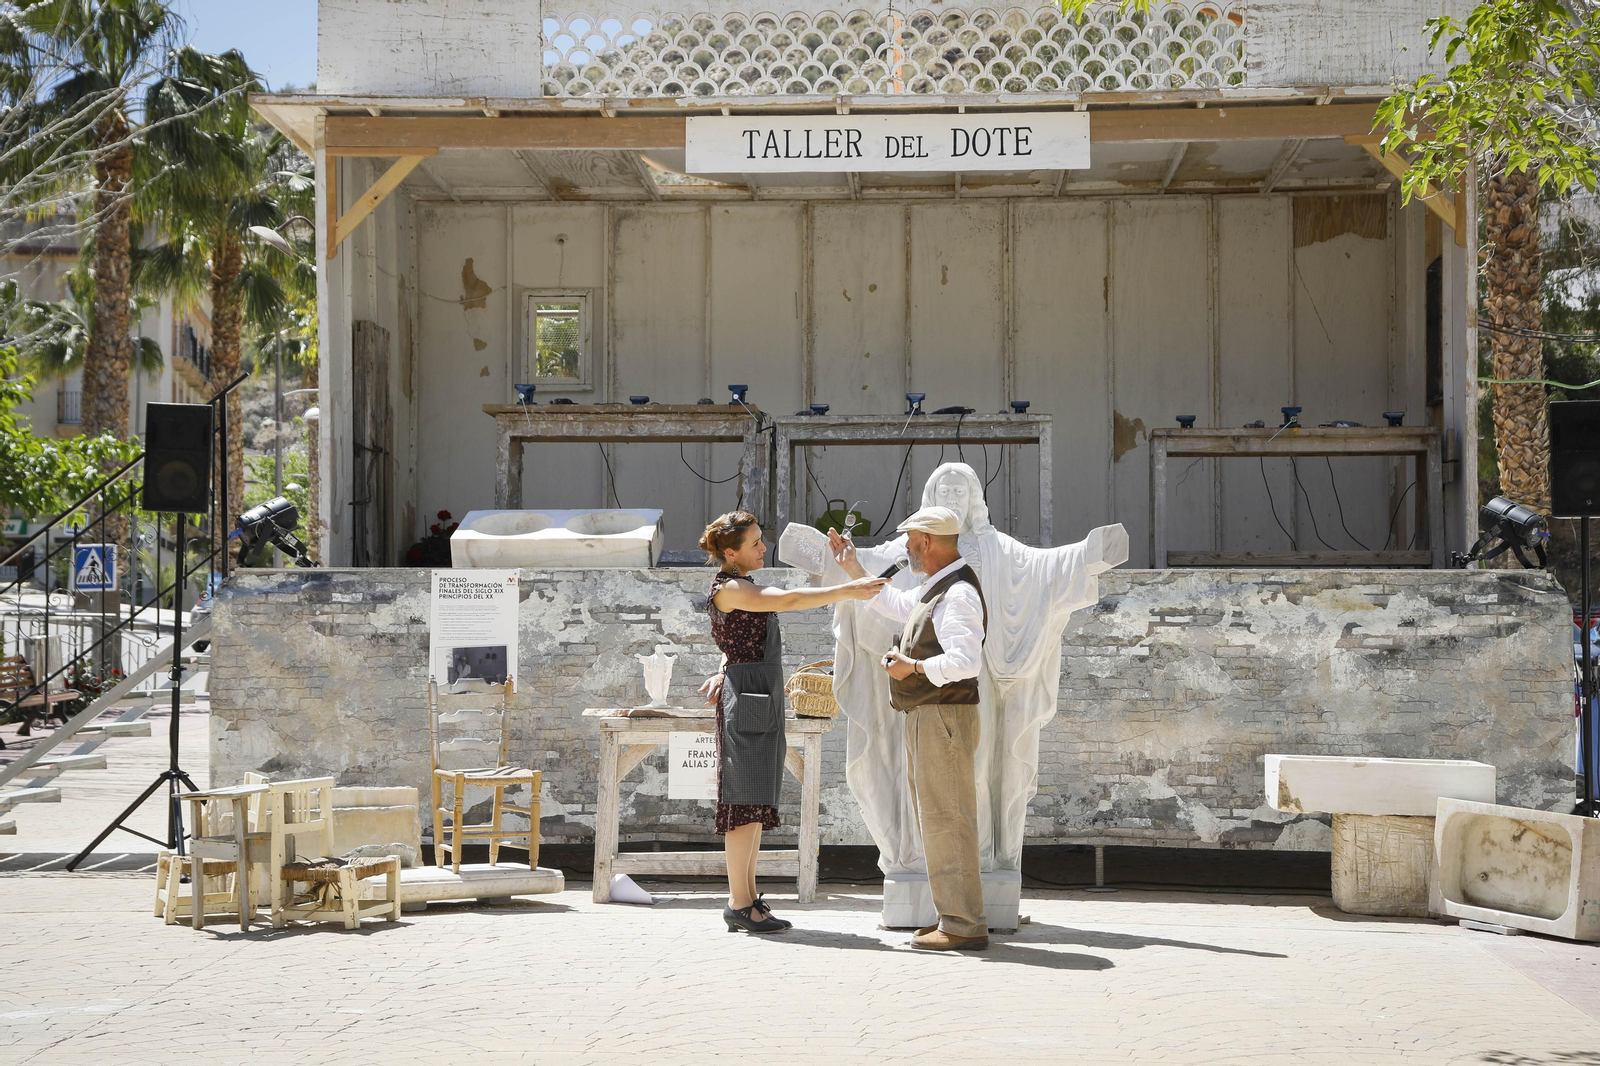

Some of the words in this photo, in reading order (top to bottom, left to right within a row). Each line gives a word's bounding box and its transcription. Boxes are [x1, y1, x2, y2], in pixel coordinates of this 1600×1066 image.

[742, 129, 863, 159] TALLER
[885, 135, 929, 159] DEL
[951, 127, 1033, 158] DOTE
[682, 760, 709, 768] ALIAS
